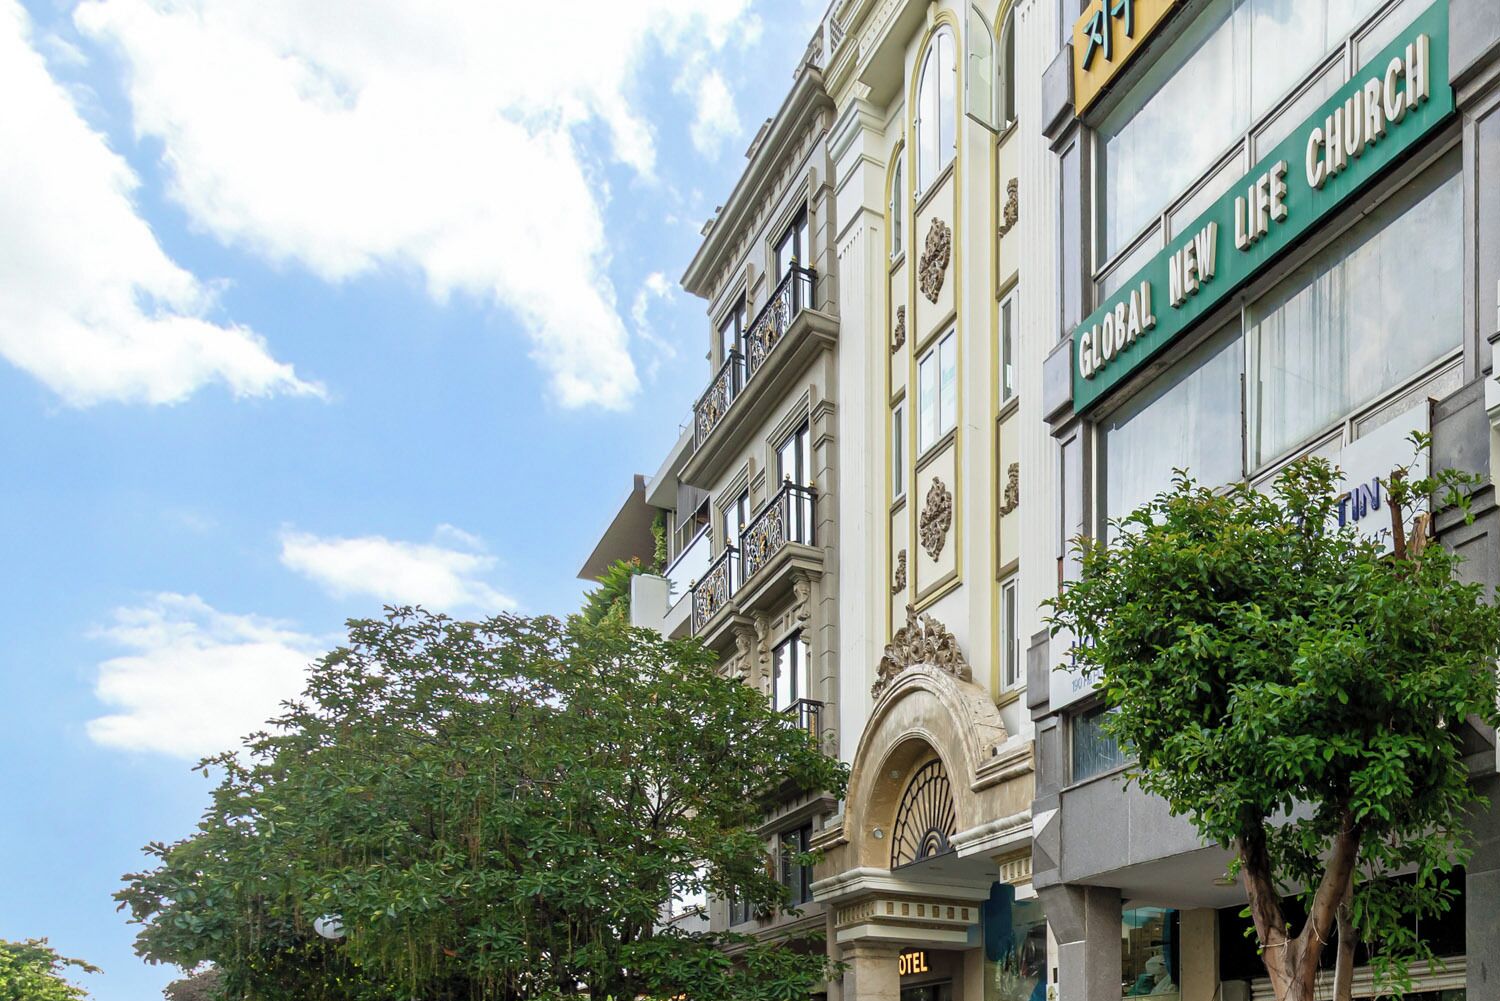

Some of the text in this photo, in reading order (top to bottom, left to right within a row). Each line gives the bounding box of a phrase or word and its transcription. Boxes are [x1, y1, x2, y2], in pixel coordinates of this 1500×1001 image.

[1078, 33, 1430, 381] GLOBAL NEW LIFE CHURCH
